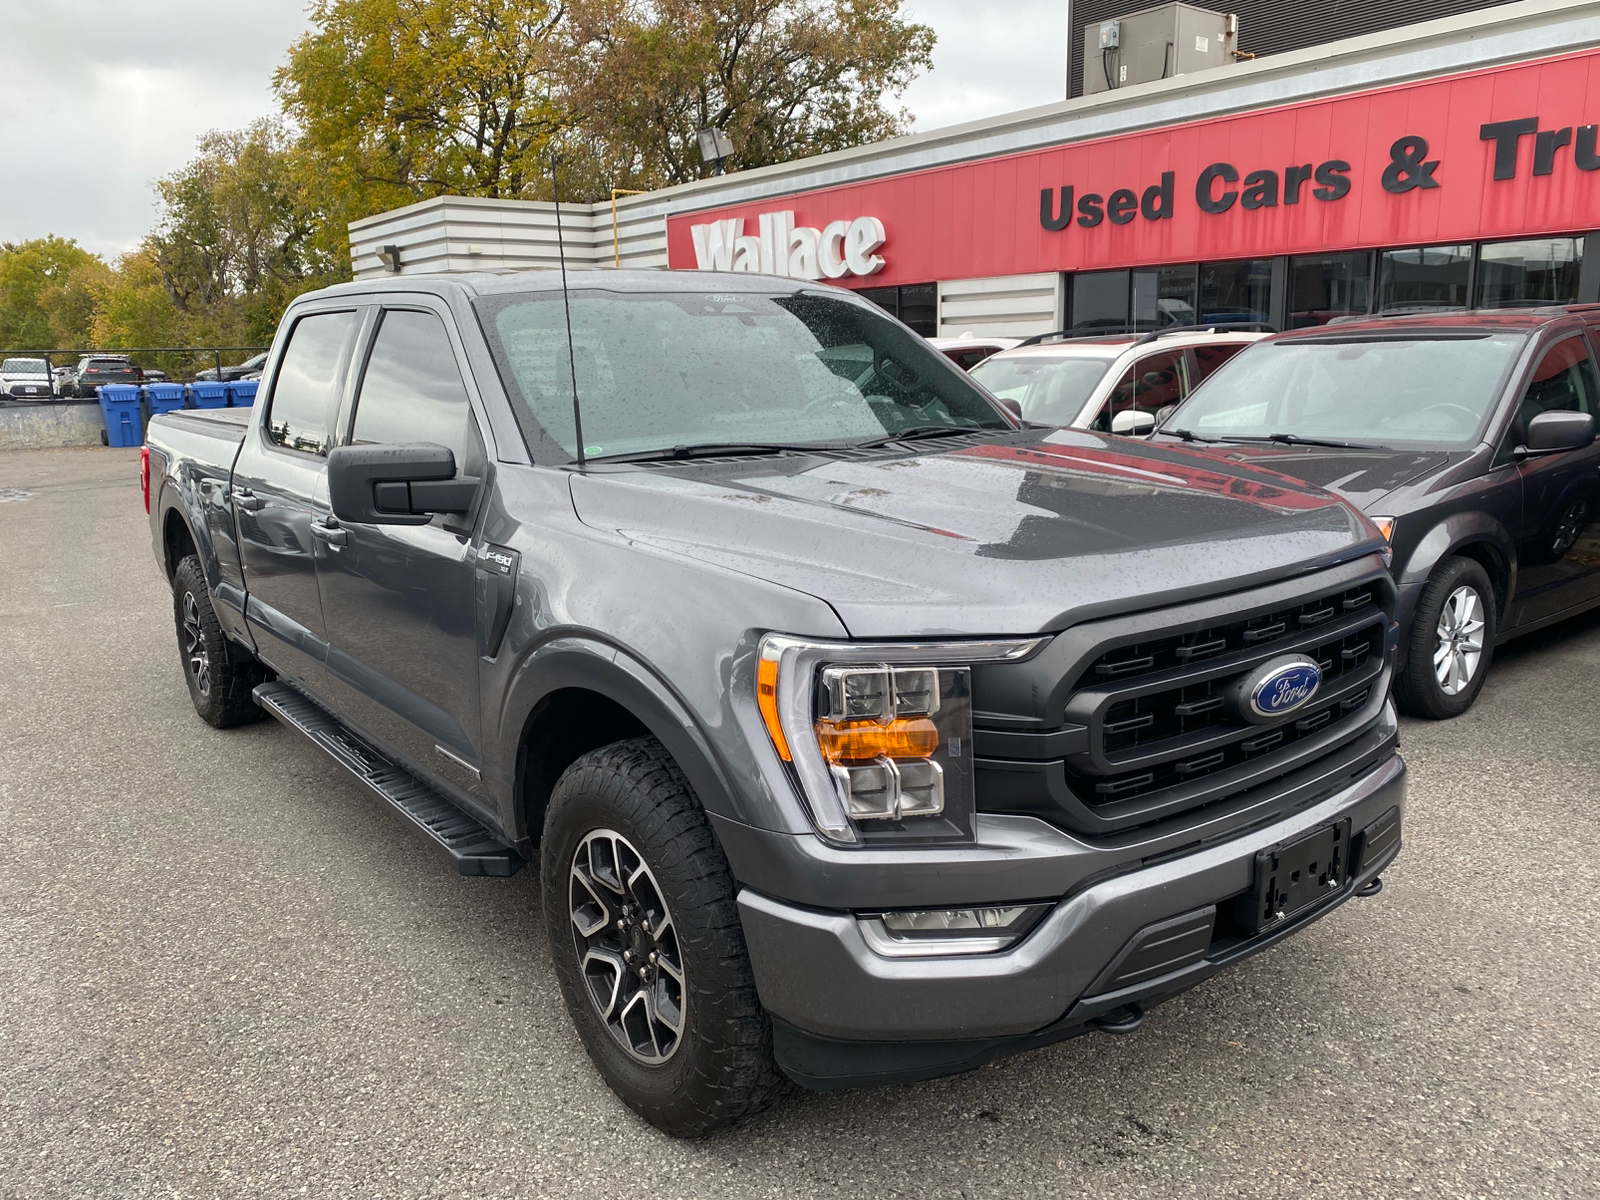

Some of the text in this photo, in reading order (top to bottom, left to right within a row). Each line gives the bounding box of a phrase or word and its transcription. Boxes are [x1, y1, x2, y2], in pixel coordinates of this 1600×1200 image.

[1039, 171, 1175, 231] Used
[1195, 159, 1351, 214] Cars
[1381, 135, 1441, 194] &
[690, 210, 887, 280] Wallace
[1271, 673, 1310, 708] Ford
